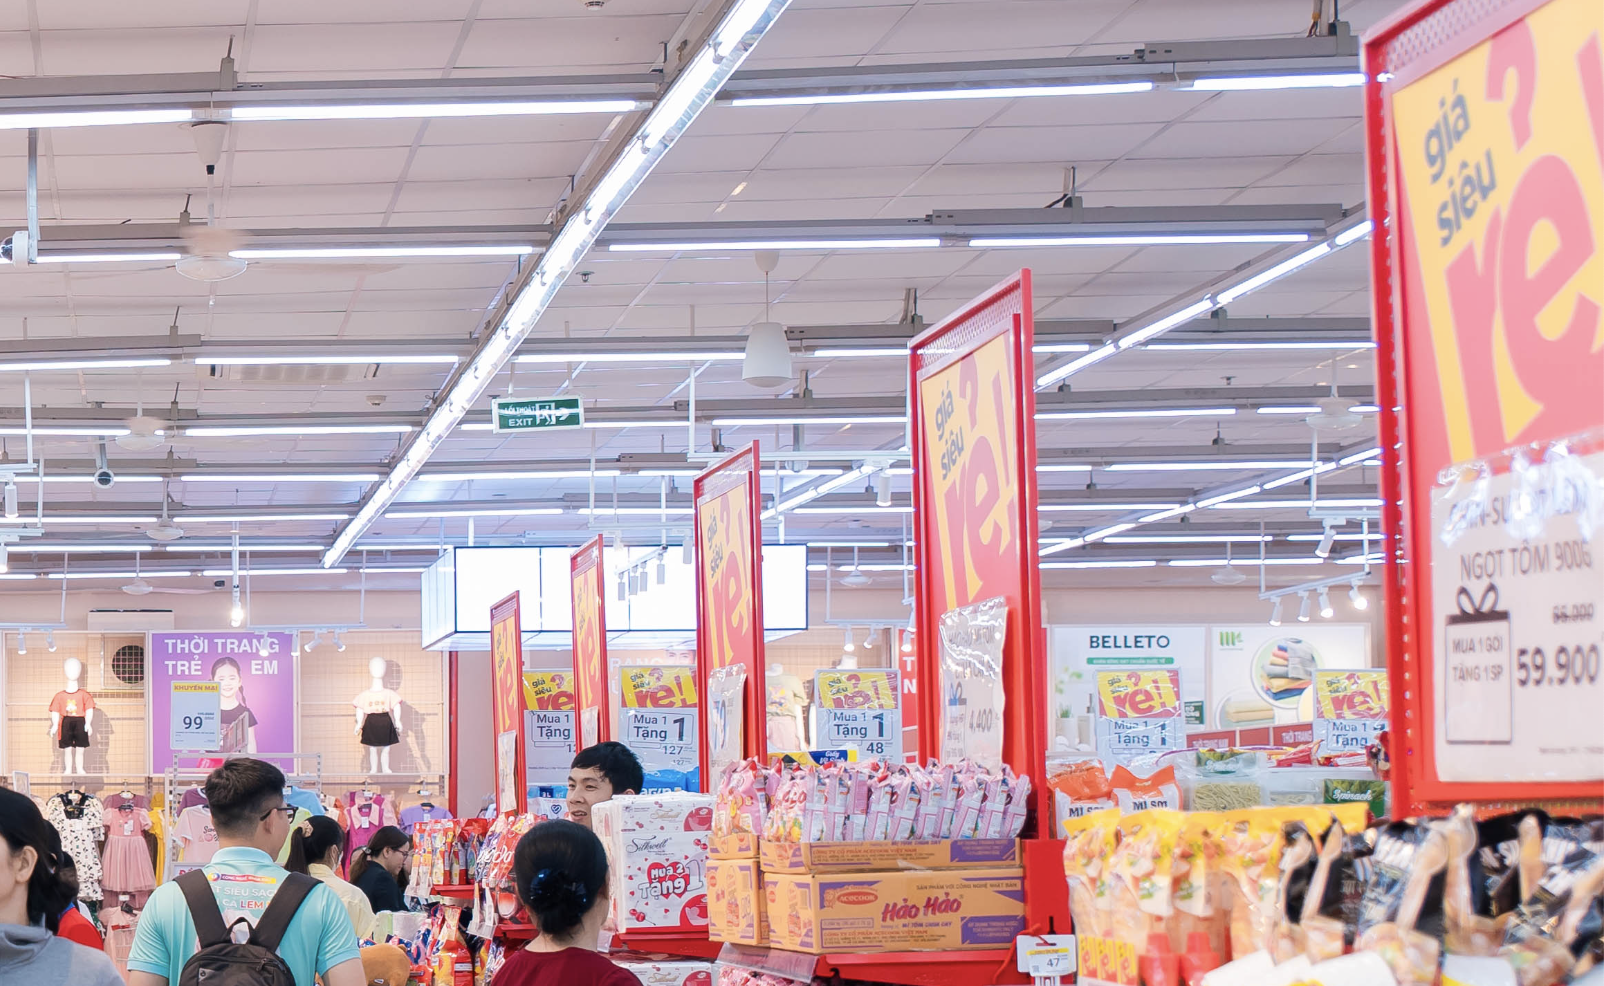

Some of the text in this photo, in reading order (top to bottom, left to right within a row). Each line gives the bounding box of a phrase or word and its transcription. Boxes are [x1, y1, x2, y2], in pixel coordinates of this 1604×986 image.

[1423, 78, 1471, 186] giá
[1435, 147, 1497, 248] siêu
[935, 378, 955, 443] giá
[508, 418, 533, 426] EXIT
[940, 424, 964, 481] siêu
[1510, 538, 1549, 576] TÔM
[164, 635, 280, 654] THỜI TRANG
[1089, 635, 1170, 649] BELLETO
[1452, 636, 1475, 654] MUA
[164, 655, 279, 675] TRẺ EM
[1516, 644, 1600, 686] 59.900
[532, 678, 546, 688] giá
[1452, 665, 1481, 689] TẶNG
[1489, 665, 1503, 682] SP
[534, 687, 552, 696] siêu
[182, 715, 204, 730] 99
[536, 714, 570, 724] Mua 1
[634, 714, 667, 725] Mua 1
[833, 712, 866, 721] Mua 1
[537, 726, 571, 739] Tặng
[634, 717, 685, 741] Tặng 1
[834, 713, 884, 738] Tặng 1
[1115, 732, 1149, 747] Tặng
[663, 746, 683, 755] 127
[866, 742, 884, 754] 48
[675, 863, 684, 874] 2
[252, 888, 276, 899] SẠC
[638, 877, 685, 900] Tặng
[882, 892, 962, 923] Hảo Hảo
[1047, 957, 1061, 968] 47
